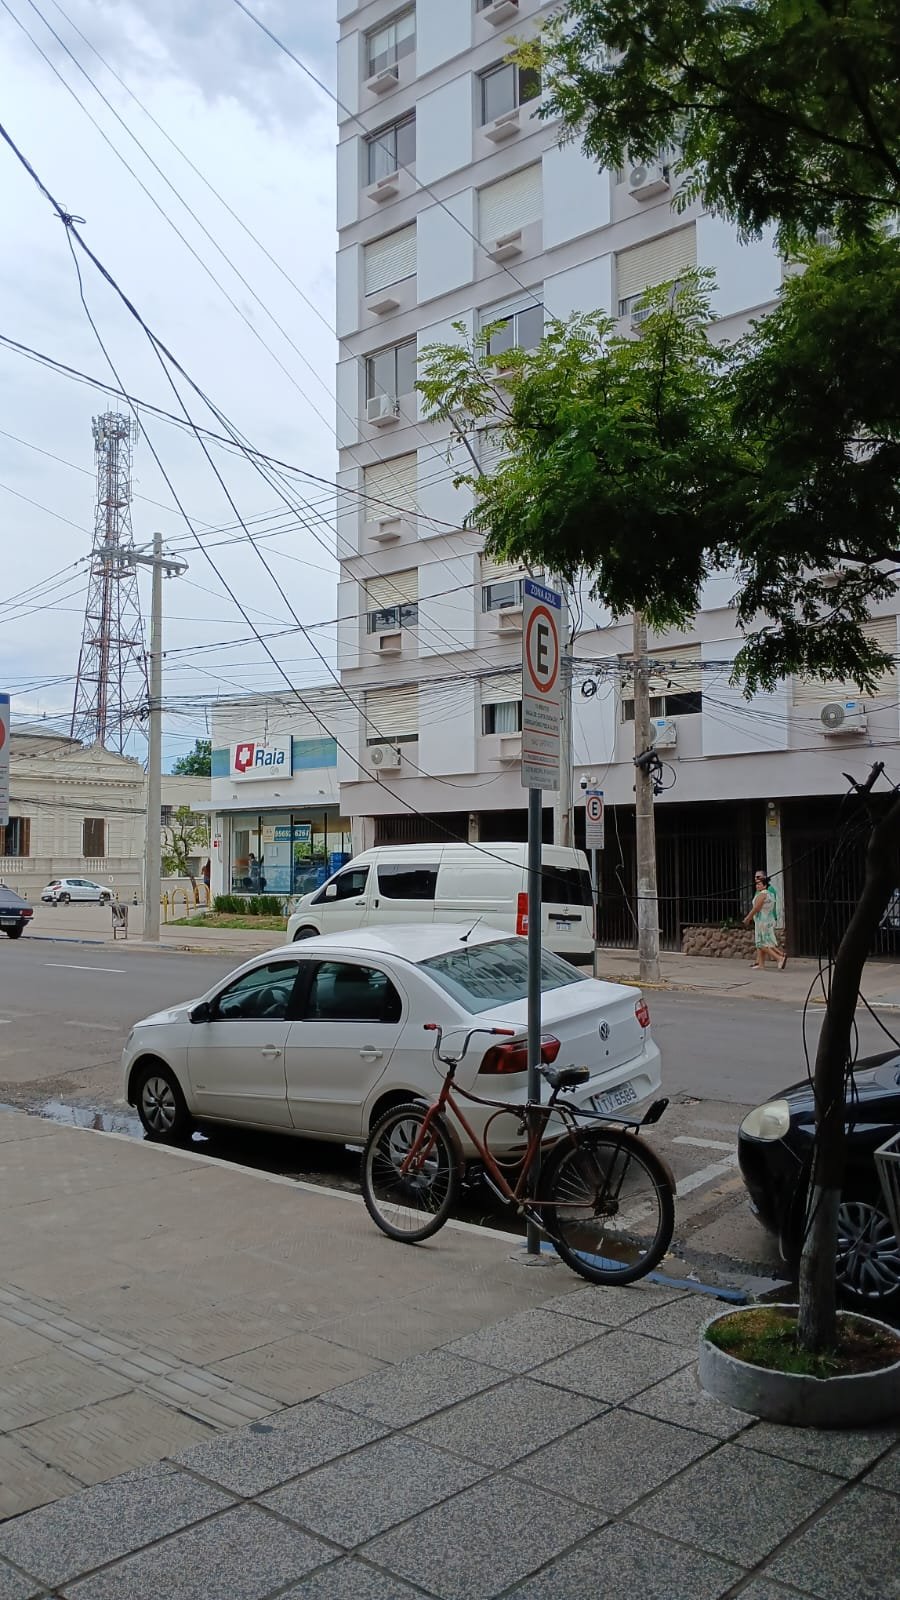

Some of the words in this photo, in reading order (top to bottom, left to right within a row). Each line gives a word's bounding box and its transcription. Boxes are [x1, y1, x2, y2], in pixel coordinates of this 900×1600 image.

[530, 584, 544, 598] ZONA
[544, 590, 557, 606] AZUL
[537, 623, 549, 675] E
[256, 748, 285, 766] Raia
[592, 801, 598, 816] E
[614, 1087, 637, 1106] 6589
